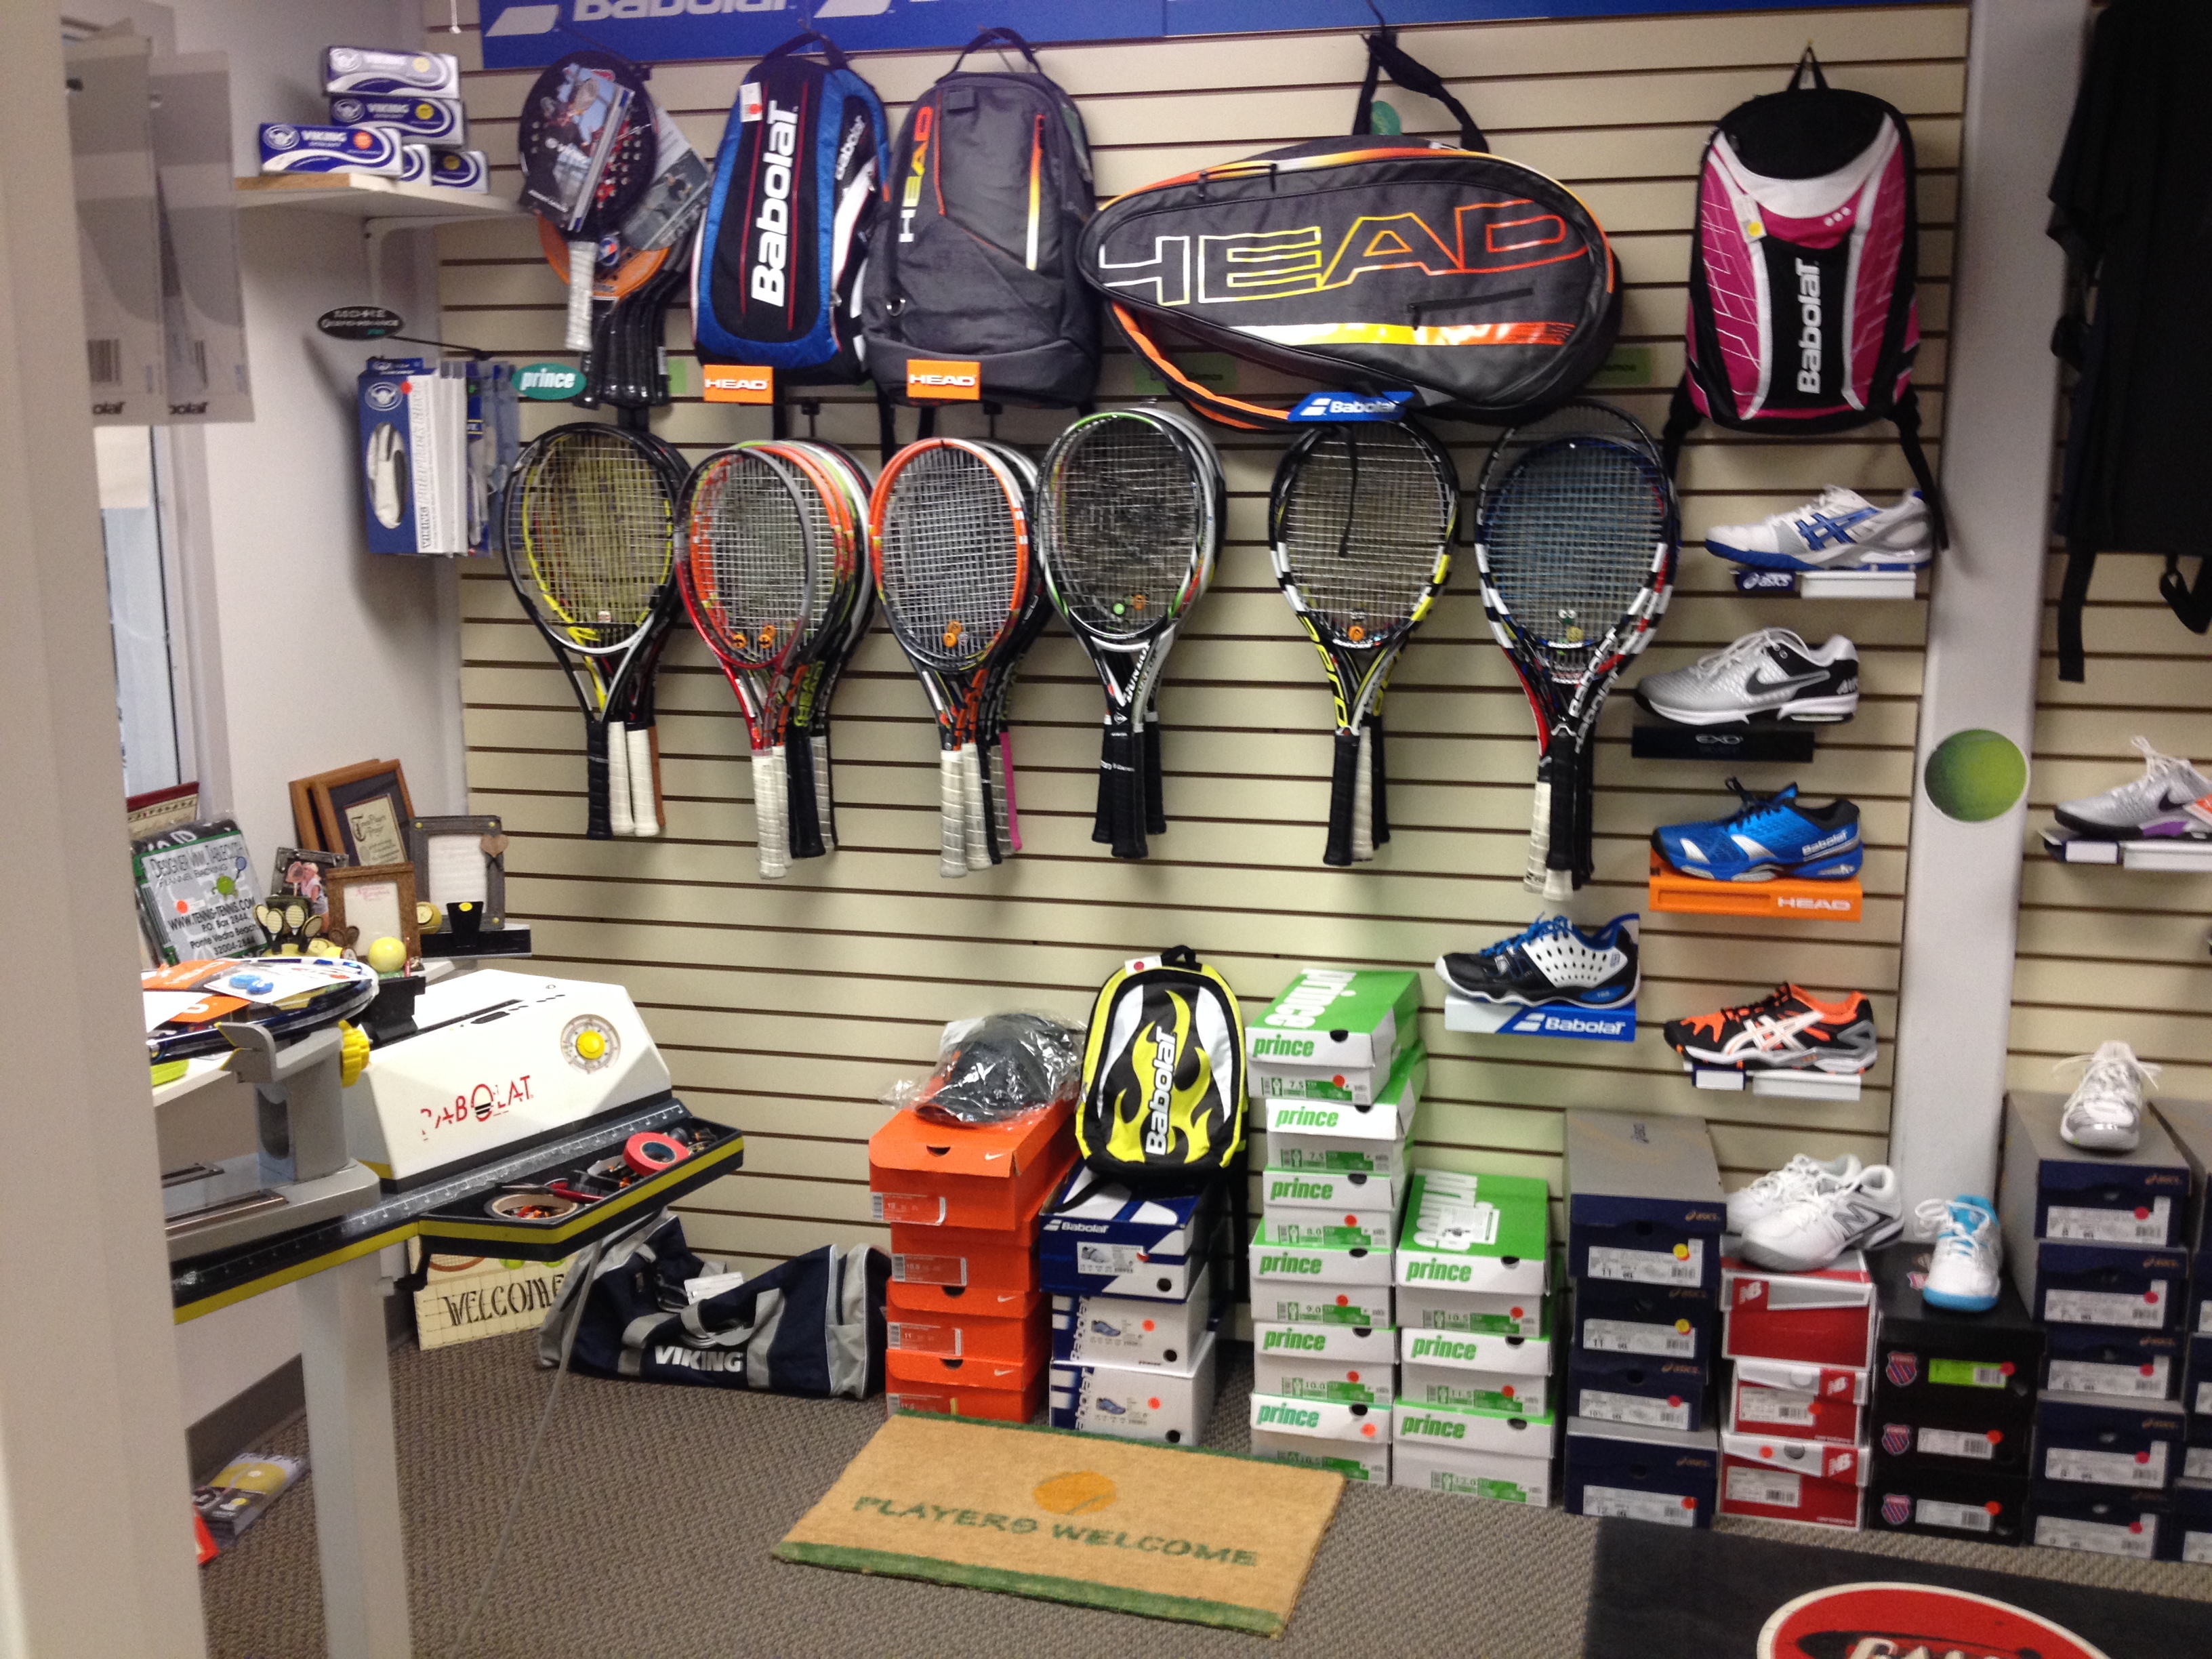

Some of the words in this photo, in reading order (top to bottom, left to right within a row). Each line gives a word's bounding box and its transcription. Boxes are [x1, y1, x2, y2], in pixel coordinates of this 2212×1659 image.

[899, 106, 933, 243] HEAD
[1098, 198, 1589, 306] HEAD
[520, 369, 577, 391] prince
[704, 379, 769, 390] HEAD
[909, 373, 977, 386] HEAD
[1777, 897, 1851, 912] HEAD
[1544, 1016, 1626, 1036] Babolat
[1253, 1033, 1315, 1058] prince
[1275, 1106, 1339, 1128] prince
[1270, 1177, 1333, 1200] prince
[1258, 1252, 1322, 1275] prince
[1406, 1257, 1473, 1282] prince
[443, 1273, 566, 1327] WELCOME
[1262, 1327, 1326, 1351] prince
[1410, 1334, 1477, 1361] prince
[654, 1345, 744, 1373] VIKING
[1256, 1402, 1320, 1428] prince
[1400, 1414, 1466, 1439] prince
[853, 1495, 1039, 1535] PLAYERS
[1052, 1523, 1258, 1568] WELCOME
